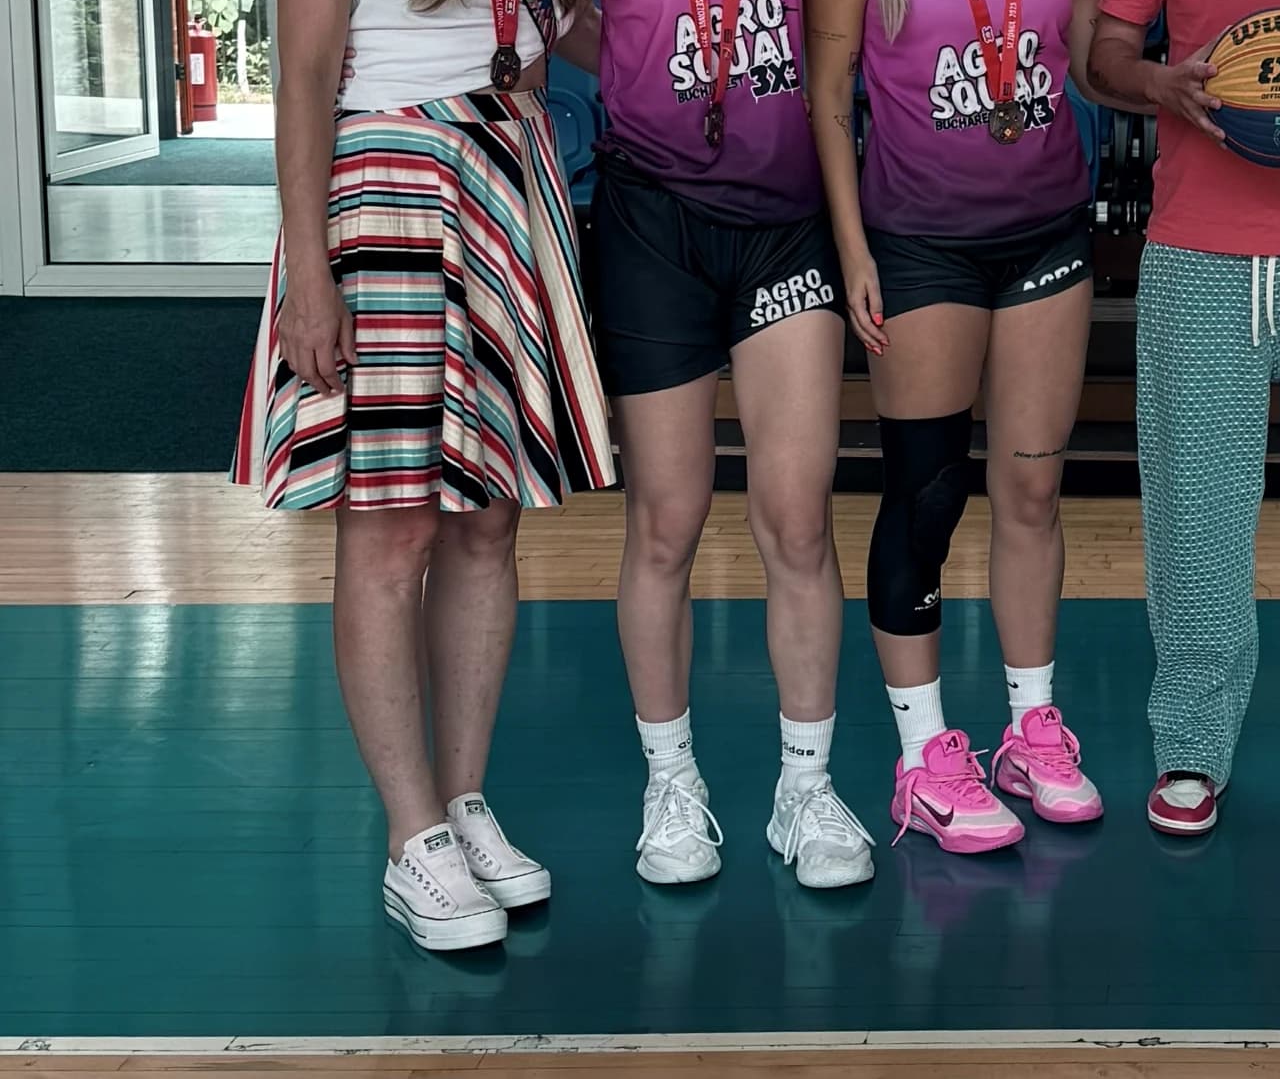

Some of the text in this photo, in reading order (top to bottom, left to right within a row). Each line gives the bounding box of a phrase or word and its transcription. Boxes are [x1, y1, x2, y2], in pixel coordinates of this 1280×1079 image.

[935, 111, 991, 131] BUCHARE
[750, 284, 834, 328] SQUAD
[755, 268, 822, 308] AGRO
